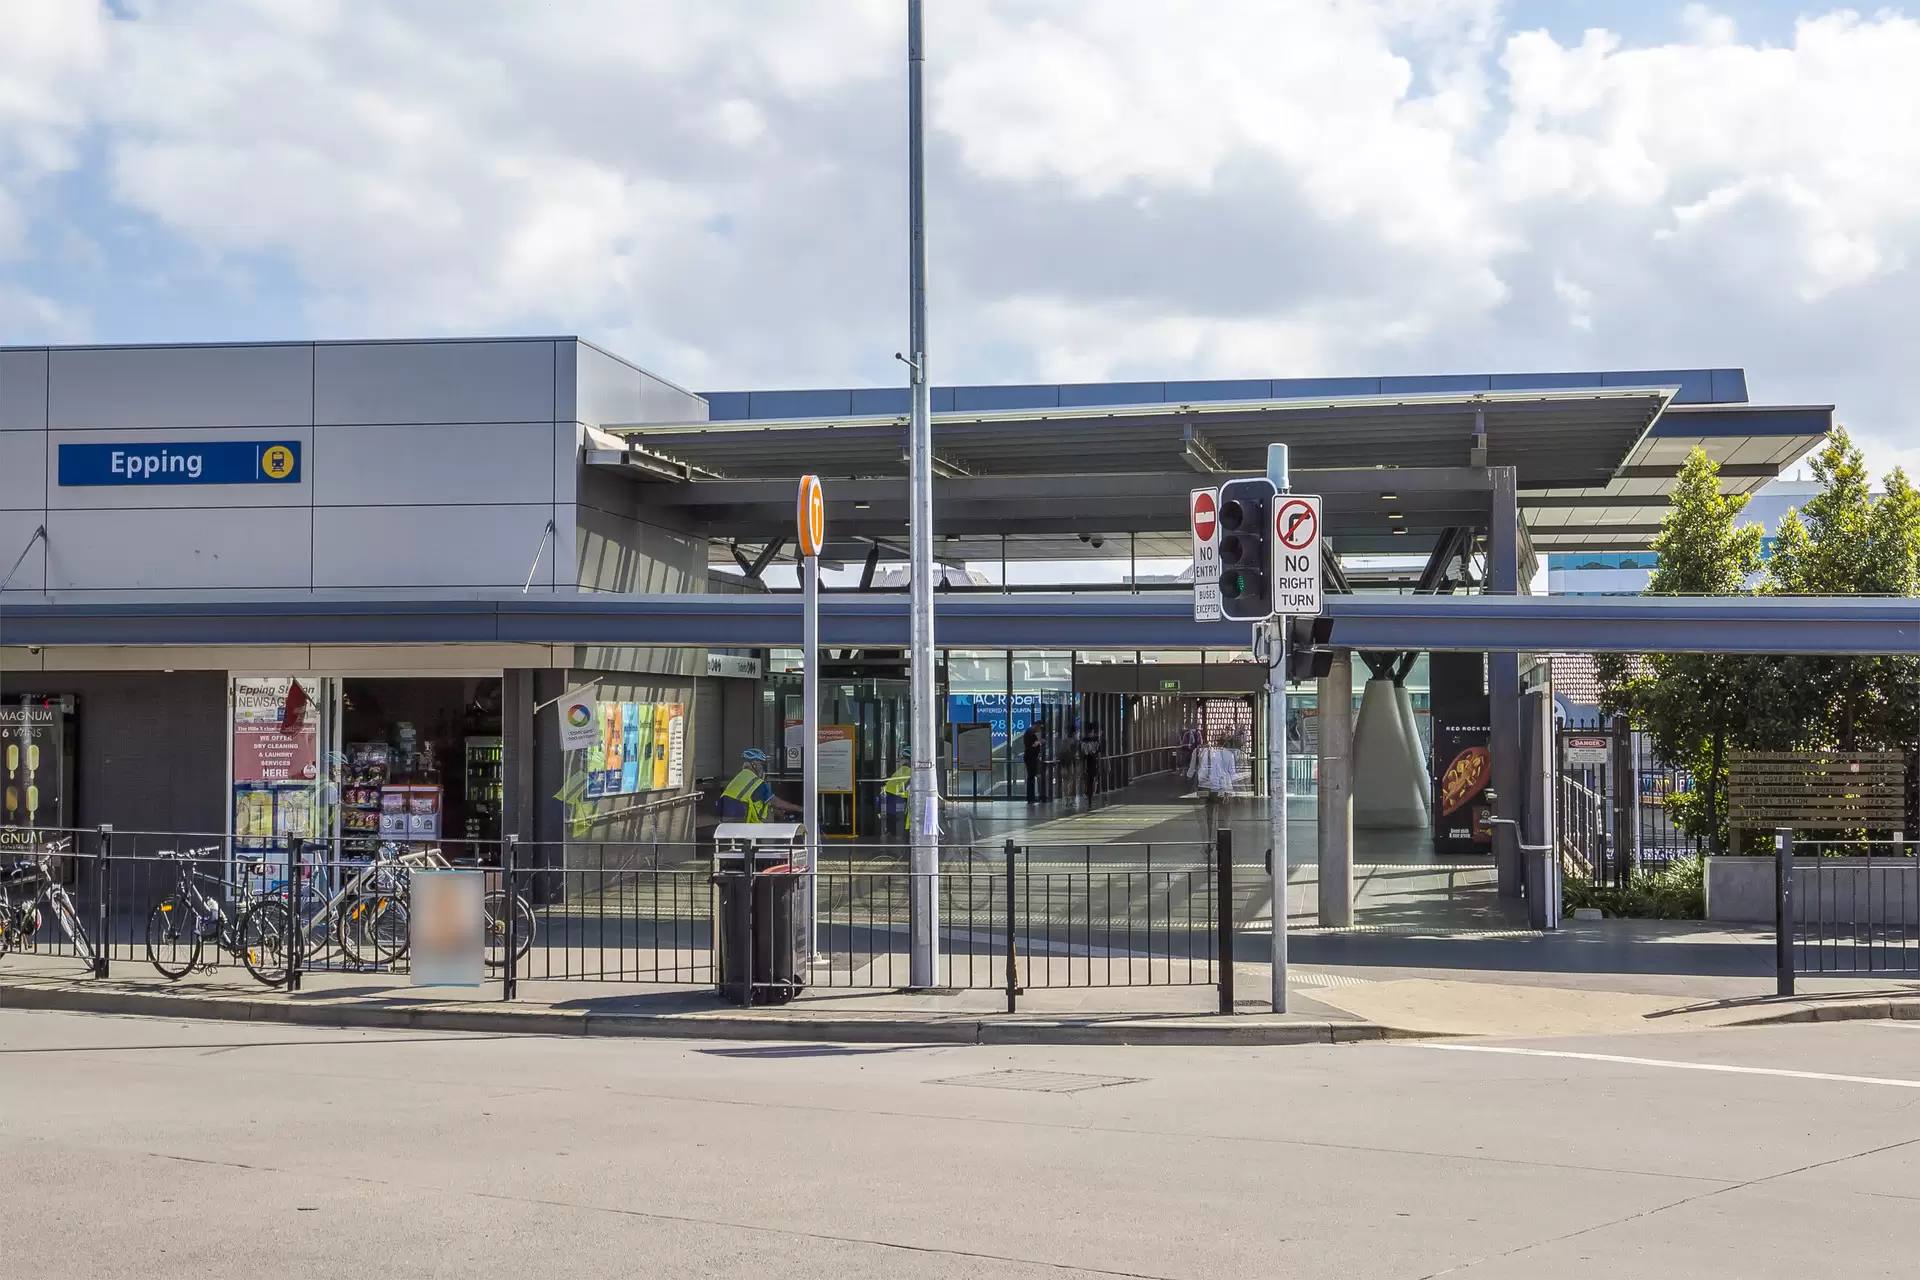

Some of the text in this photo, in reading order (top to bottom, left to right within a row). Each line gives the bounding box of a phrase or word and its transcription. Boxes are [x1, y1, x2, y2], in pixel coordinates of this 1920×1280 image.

[111, 450, 202, 478] Epping
[813, 498, 820, 536] T
[1200, 547, 1213, 561] NO
[1285, 555, 1310, 572] NO
[1196, 564, 1218, 578] ENTRY
[1279, 577, 1314, 589] RIGHT
[1199, 590, 1216, 600] BUSES
[1281, 594, 1314, 606] TURN
[1196, 603, 1220, 614] EXCEPTED
[239, 685, 276, 697] Epping
[238, 696, 315, 708] NEWSAGY
[0, 711, 53, 721] MAGNUM
[13, 728, 43, 738] WINS
[262, 768, 289, 778] HERE
